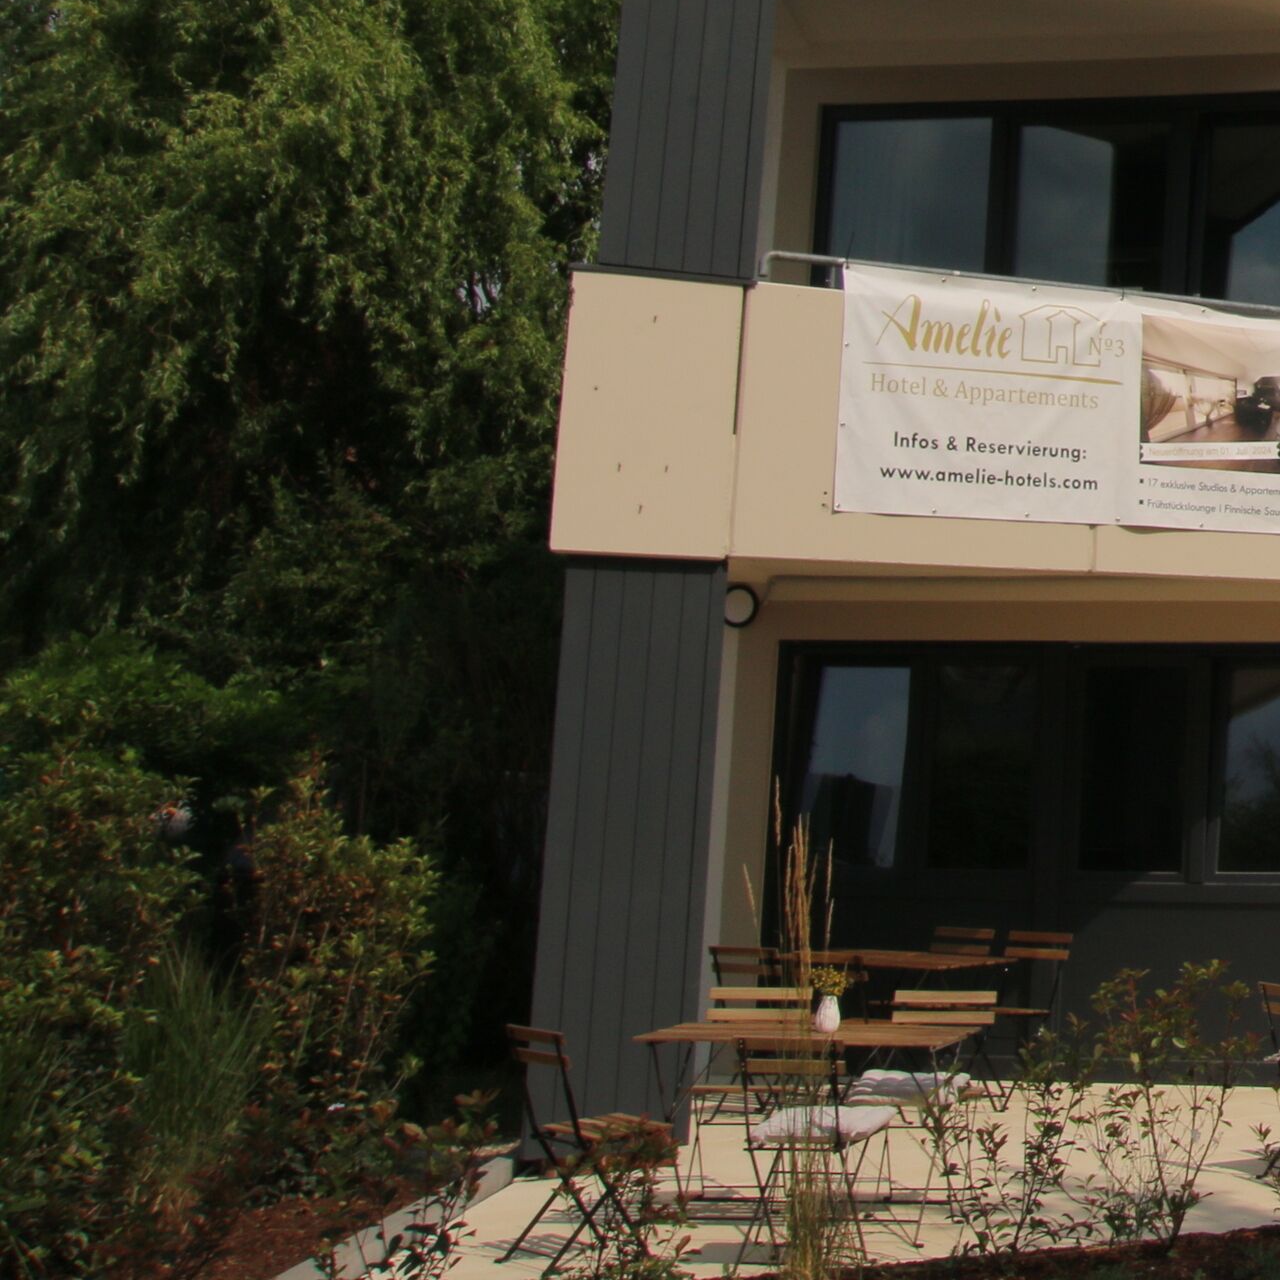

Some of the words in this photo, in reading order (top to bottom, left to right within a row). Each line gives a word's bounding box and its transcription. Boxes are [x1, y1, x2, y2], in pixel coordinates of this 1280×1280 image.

[875, 294, 1013, 359] Amelie
[871, 373, 927, 396] Hotel
[932, 378, 949, 398] &
[955, 380, 1099, 409] Appartements
[893, 431, 939, 450] Infos
[946, 436, 958, 451] &
[966, 436, 1087, 462] Reservierung:
[880, 466, 1099, 490] www.amelie-hotels.com
[1148, 477, 1159, 488] 17
[1160, 480, 1196, 491] exklusive
[1198, 481, 1228, 493] Studios
[1230, 484, 1237, 493] &
[1147, 499, 1217, 514] Frühstückslounge
[1224, 504, 1261, 516] Finnische
